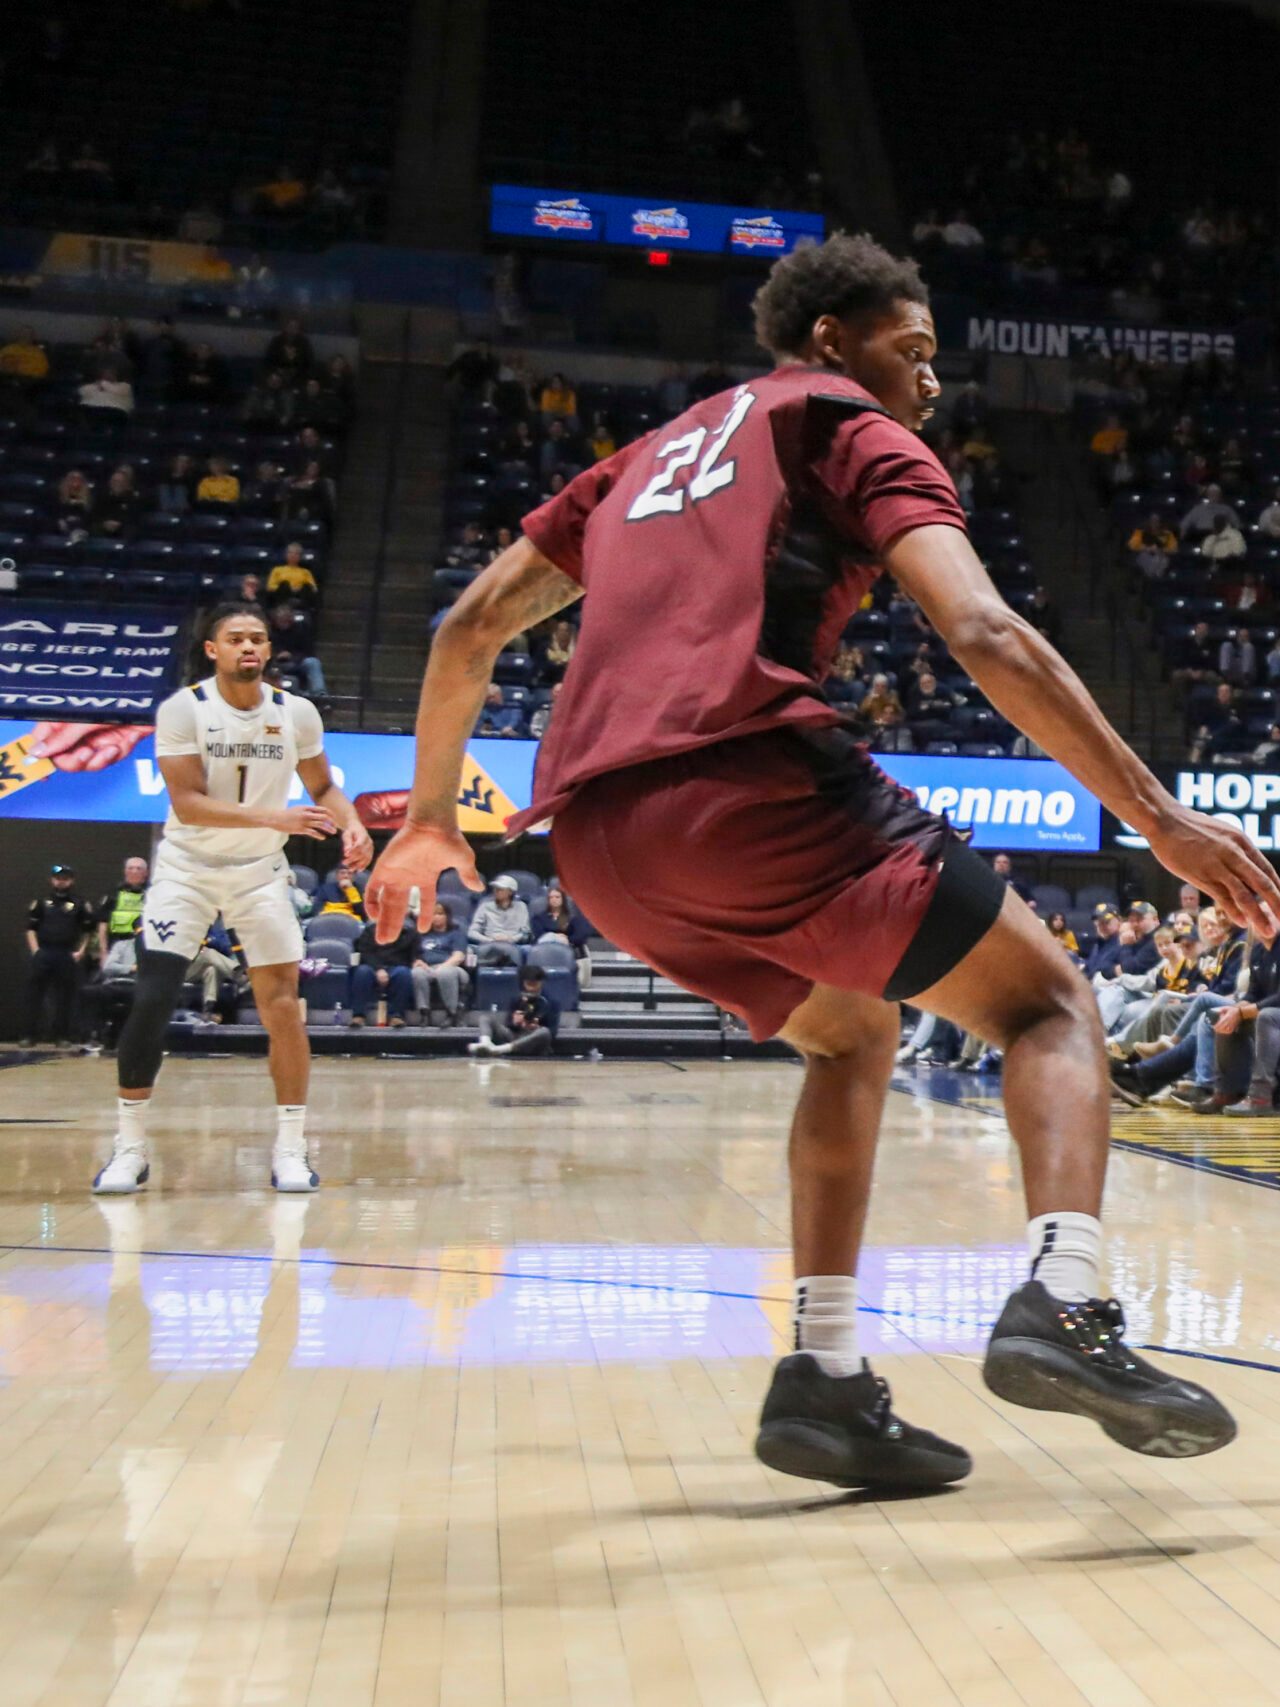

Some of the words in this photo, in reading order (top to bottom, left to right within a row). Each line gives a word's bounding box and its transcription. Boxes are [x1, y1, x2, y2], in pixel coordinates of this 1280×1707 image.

[625, 391, 756, 521] 22
[43, 645, 107, 655] JEEP
[114, 647, 171, 656] RAM
[207, 743, 283, 760] MOUNTAINEERS
[237, 765, 248, 803] 1
